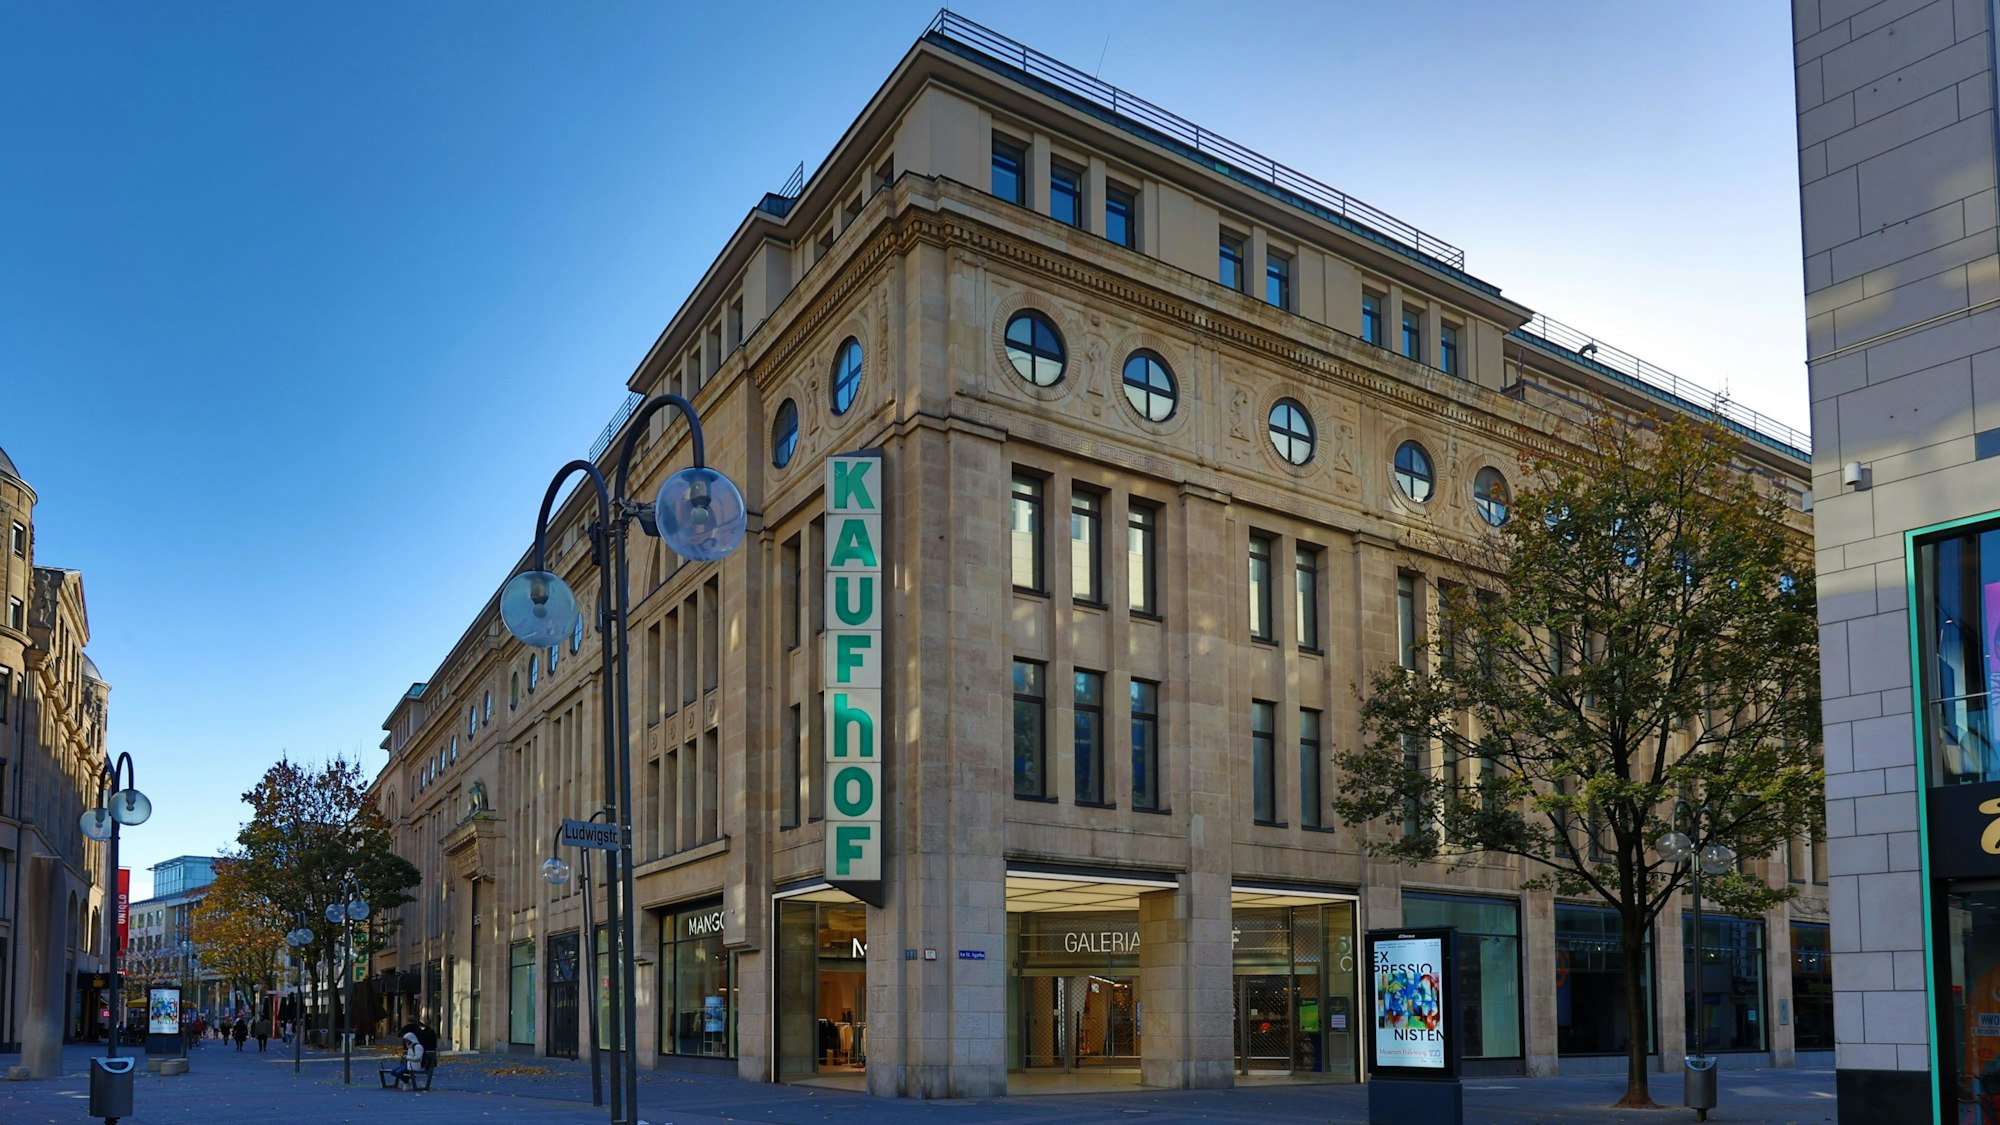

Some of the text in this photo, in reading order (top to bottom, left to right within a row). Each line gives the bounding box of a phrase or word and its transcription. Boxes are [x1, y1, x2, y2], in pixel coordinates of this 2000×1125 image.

[565, 823, 618, 846] Ludwigstr.
[118, 894, 127, 924] UNIQLO
[1064, 932, 1140, 952] GALERIA
